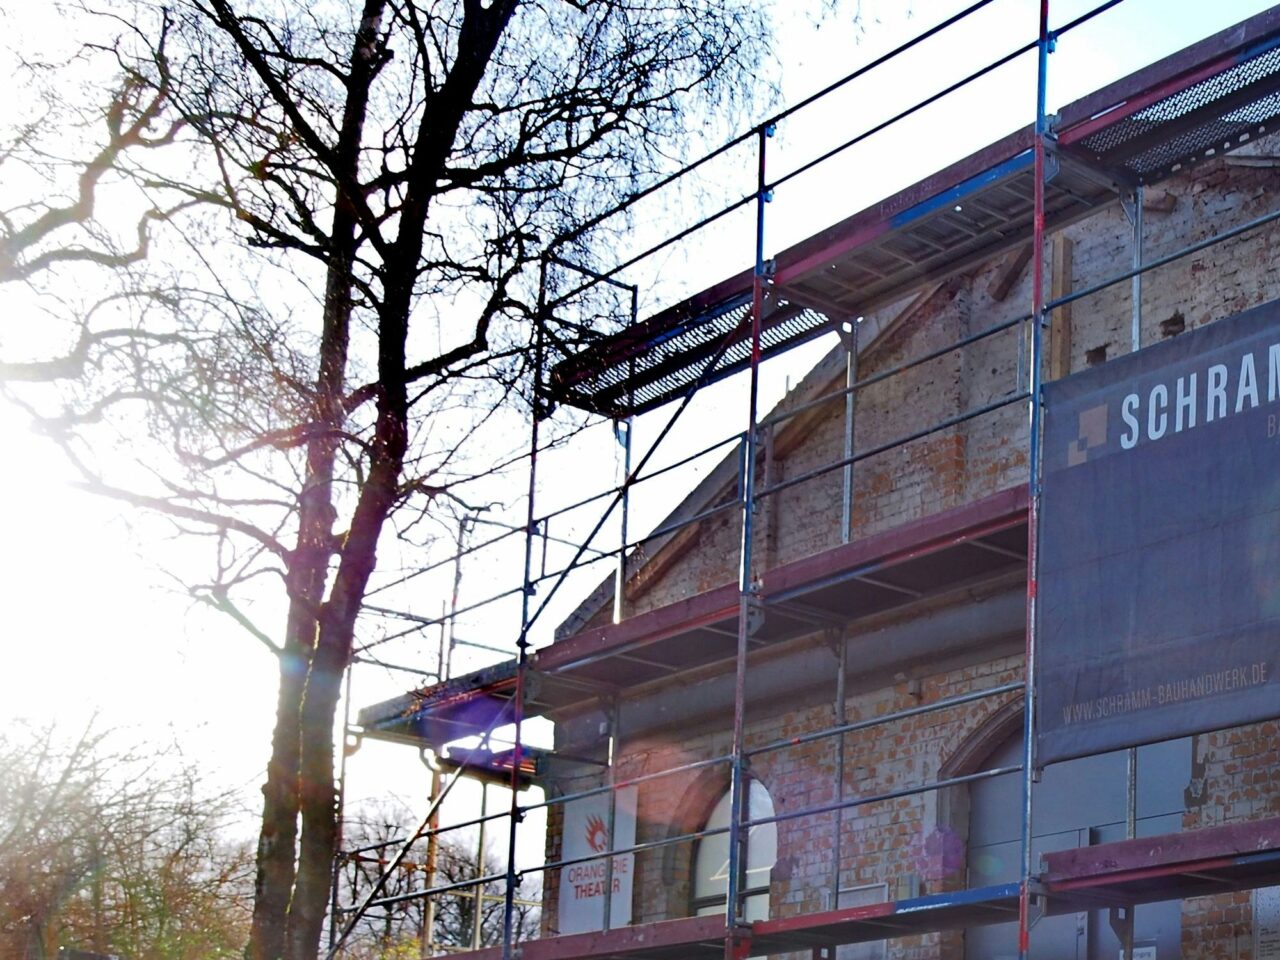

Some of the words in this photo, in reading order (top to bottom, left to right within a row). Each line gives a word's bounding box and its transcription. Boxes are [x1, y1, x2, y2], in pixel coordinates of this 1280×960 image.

[1062, 661, 1267, 725] WWW.SCHRAMM-BAUHANDWERK.DE
[568, 858, 628, 883] ORANGRIE
[574, 878, 621, 899] THEATR
